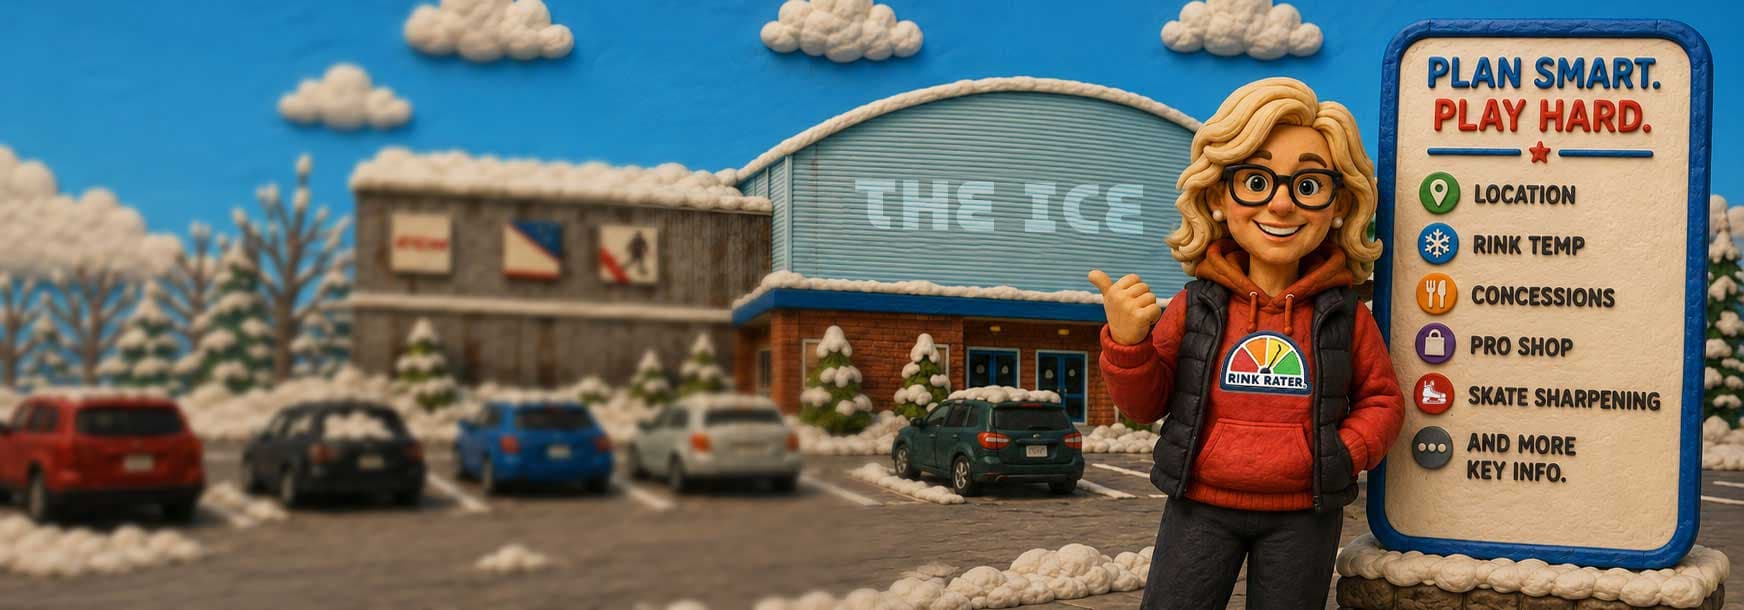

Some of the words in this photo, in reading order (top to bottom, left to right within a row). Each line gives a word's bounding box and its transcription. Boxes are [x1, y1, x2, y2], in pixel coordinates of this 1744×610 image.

[1427, 56, 1522, 90] PLAN
[1533, 56, 1662, 90] SMART.
[1433, 98, 1527, 132] PLAY
[1539, 99, 1652, 133] HARD.
[1474, 184, 1576, 205] LOCATION
[854, 178, 995, 232] THE
[1024, 182, 1144, 235] ICE
[1473, 235, 1522, 255] RINK
[1528, 236, 1586, 257] TEMP
[1471, 285, 1616, 308] CONCESSIONS
[1470, 335, 1511, 356] PRO
[1517, 336, 1574, 357] SHOP
[1228, 373, 1260, 384] RINK
[1468, 386, 1529, 407] SKATE
[1534, 388, 1661, 412] SHARPENING
[1466, 433, 1511, 454] AND
[1517, 435, 1577, 457] MORE
[1466, 460, 1507, 481] KEY
[1512, 462, 1567, 483] INFO.
